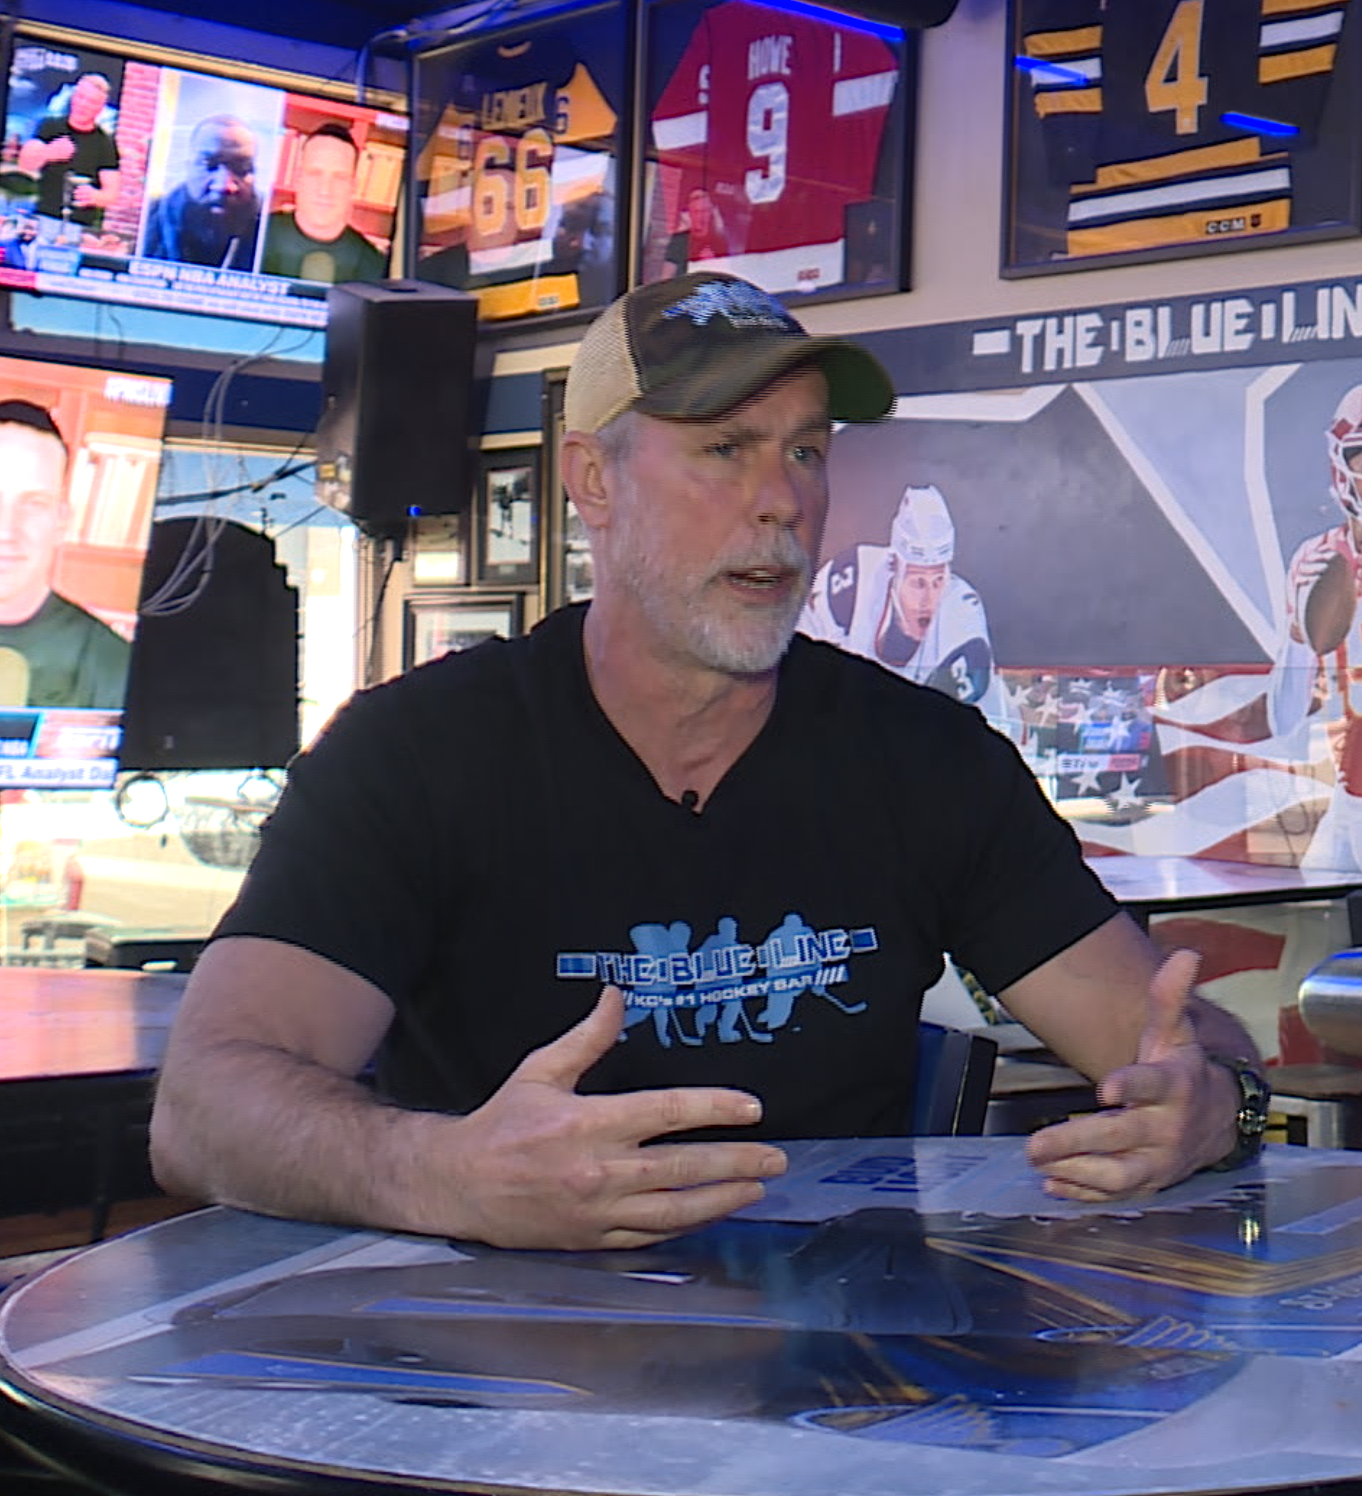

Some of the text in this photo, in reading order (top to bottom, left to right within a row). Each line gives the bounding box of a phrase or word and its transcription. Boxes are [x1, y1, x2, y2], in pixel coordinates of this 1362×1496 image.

[747, 34, 793, 80] HOWE
[1145, 0, 1208, 135] 4
[744, 81, 790, 204] 9
[473, 127, 554, 237] 66
[1206, 217, 1247, 235] CCM
[1015, 312, 1105, 374] THE
[1124, 298, 1256, 362] BLUE
[599, 928, 851, 985] THE BLUE LINE
[700, 981, 769, 1004] HOCKEY
[773, 974, 814, 992] BAR
